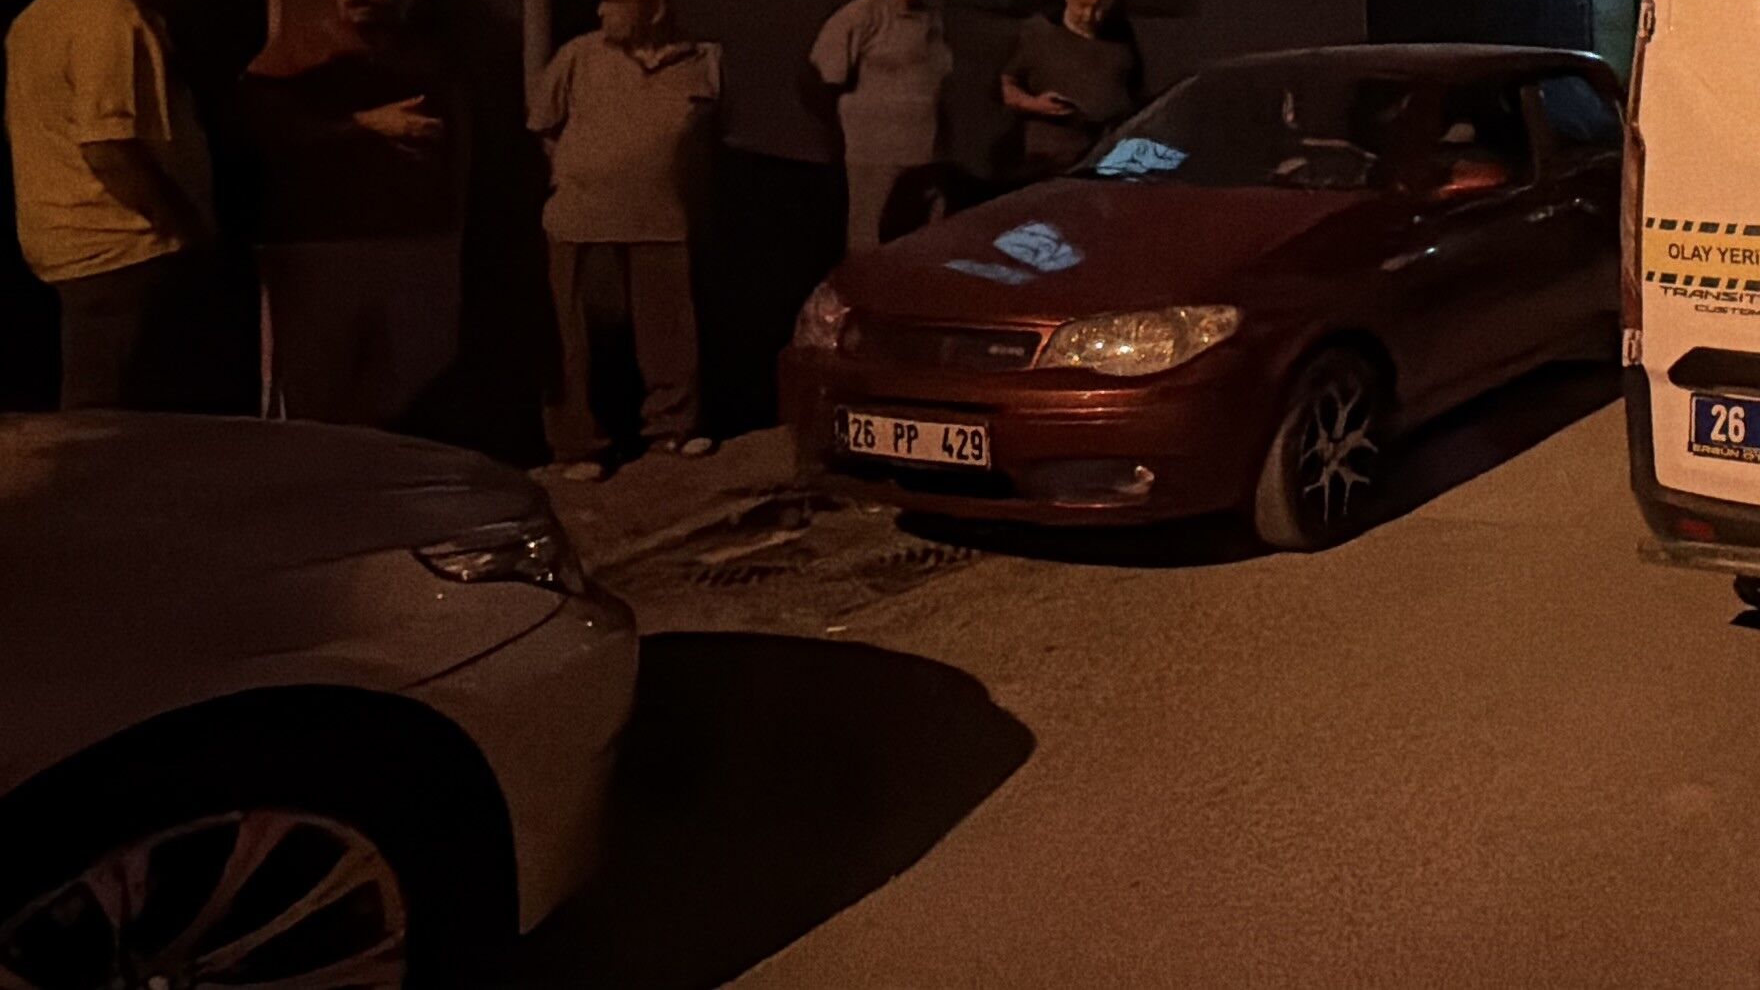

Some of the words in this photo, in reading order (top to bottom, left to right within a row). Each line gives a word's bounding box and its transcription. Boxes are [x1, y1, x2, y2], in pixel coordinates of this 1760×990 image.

[1668, 243, 1712, 262] OLAY
[852, 418, 875, 448] 26
[893, 423, 919, 453] PP
[942, 427, 983, 460] 429
[1710, 404, 1745, 443] 26
